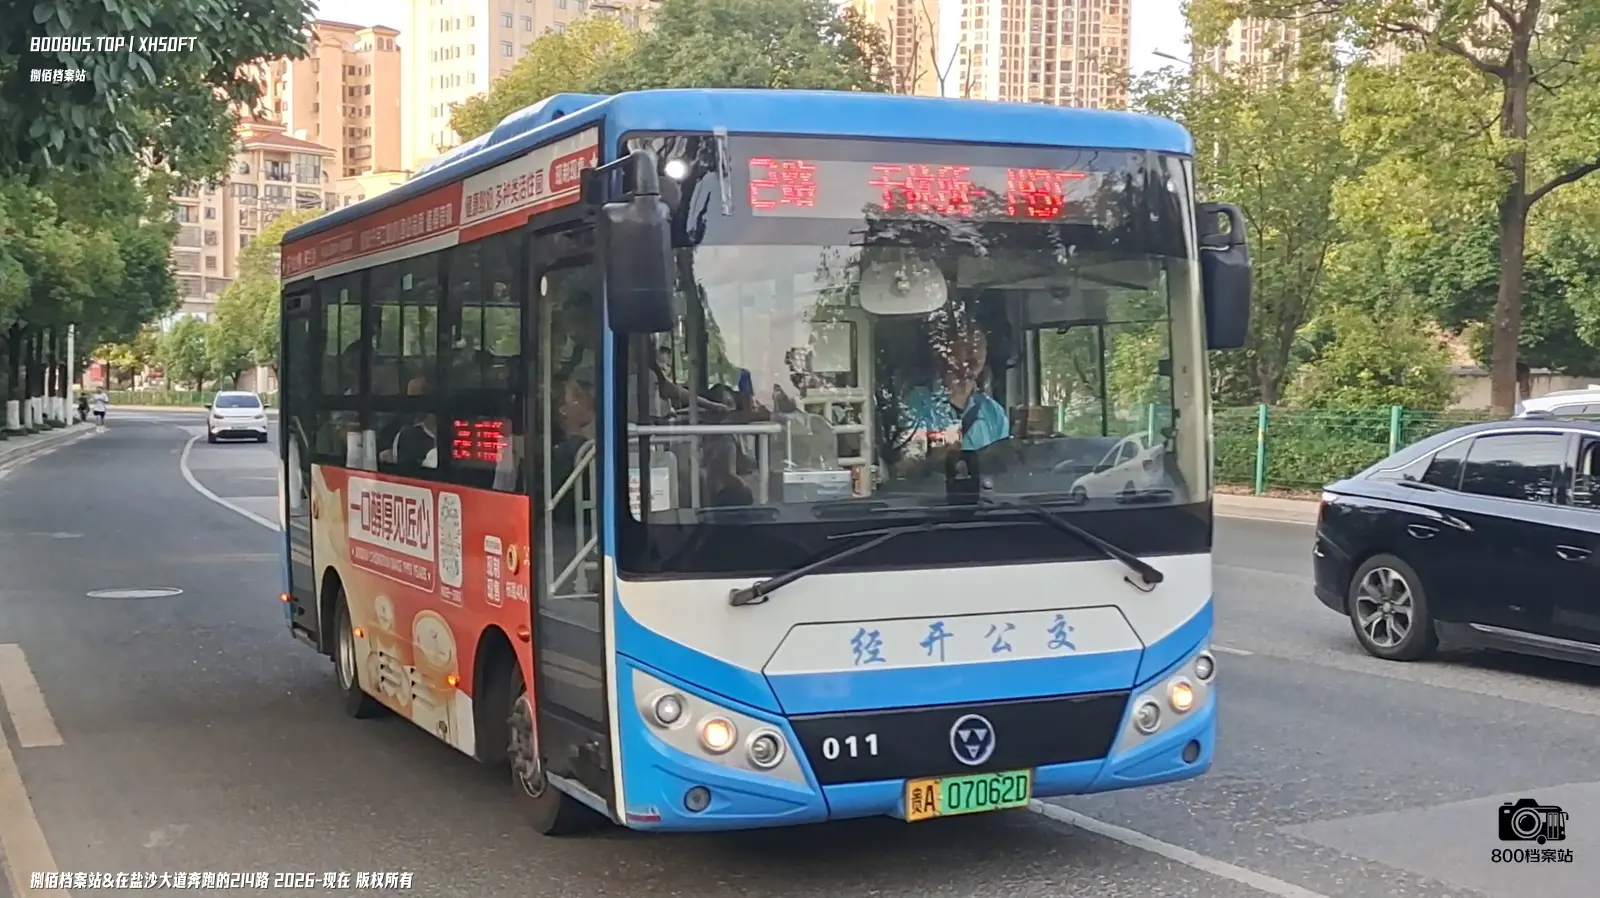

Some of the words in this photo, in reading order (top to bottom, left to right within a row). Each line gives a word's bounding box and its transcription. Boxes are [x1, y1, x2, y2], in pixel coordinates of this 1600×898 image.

[350, 490, 431, 550] 一口醇厚见匠心
[850, 613, 1077, 666] 经开公交
[822, 733, 880, 760] 011
[947, 774, 1029, 811] 07062D
